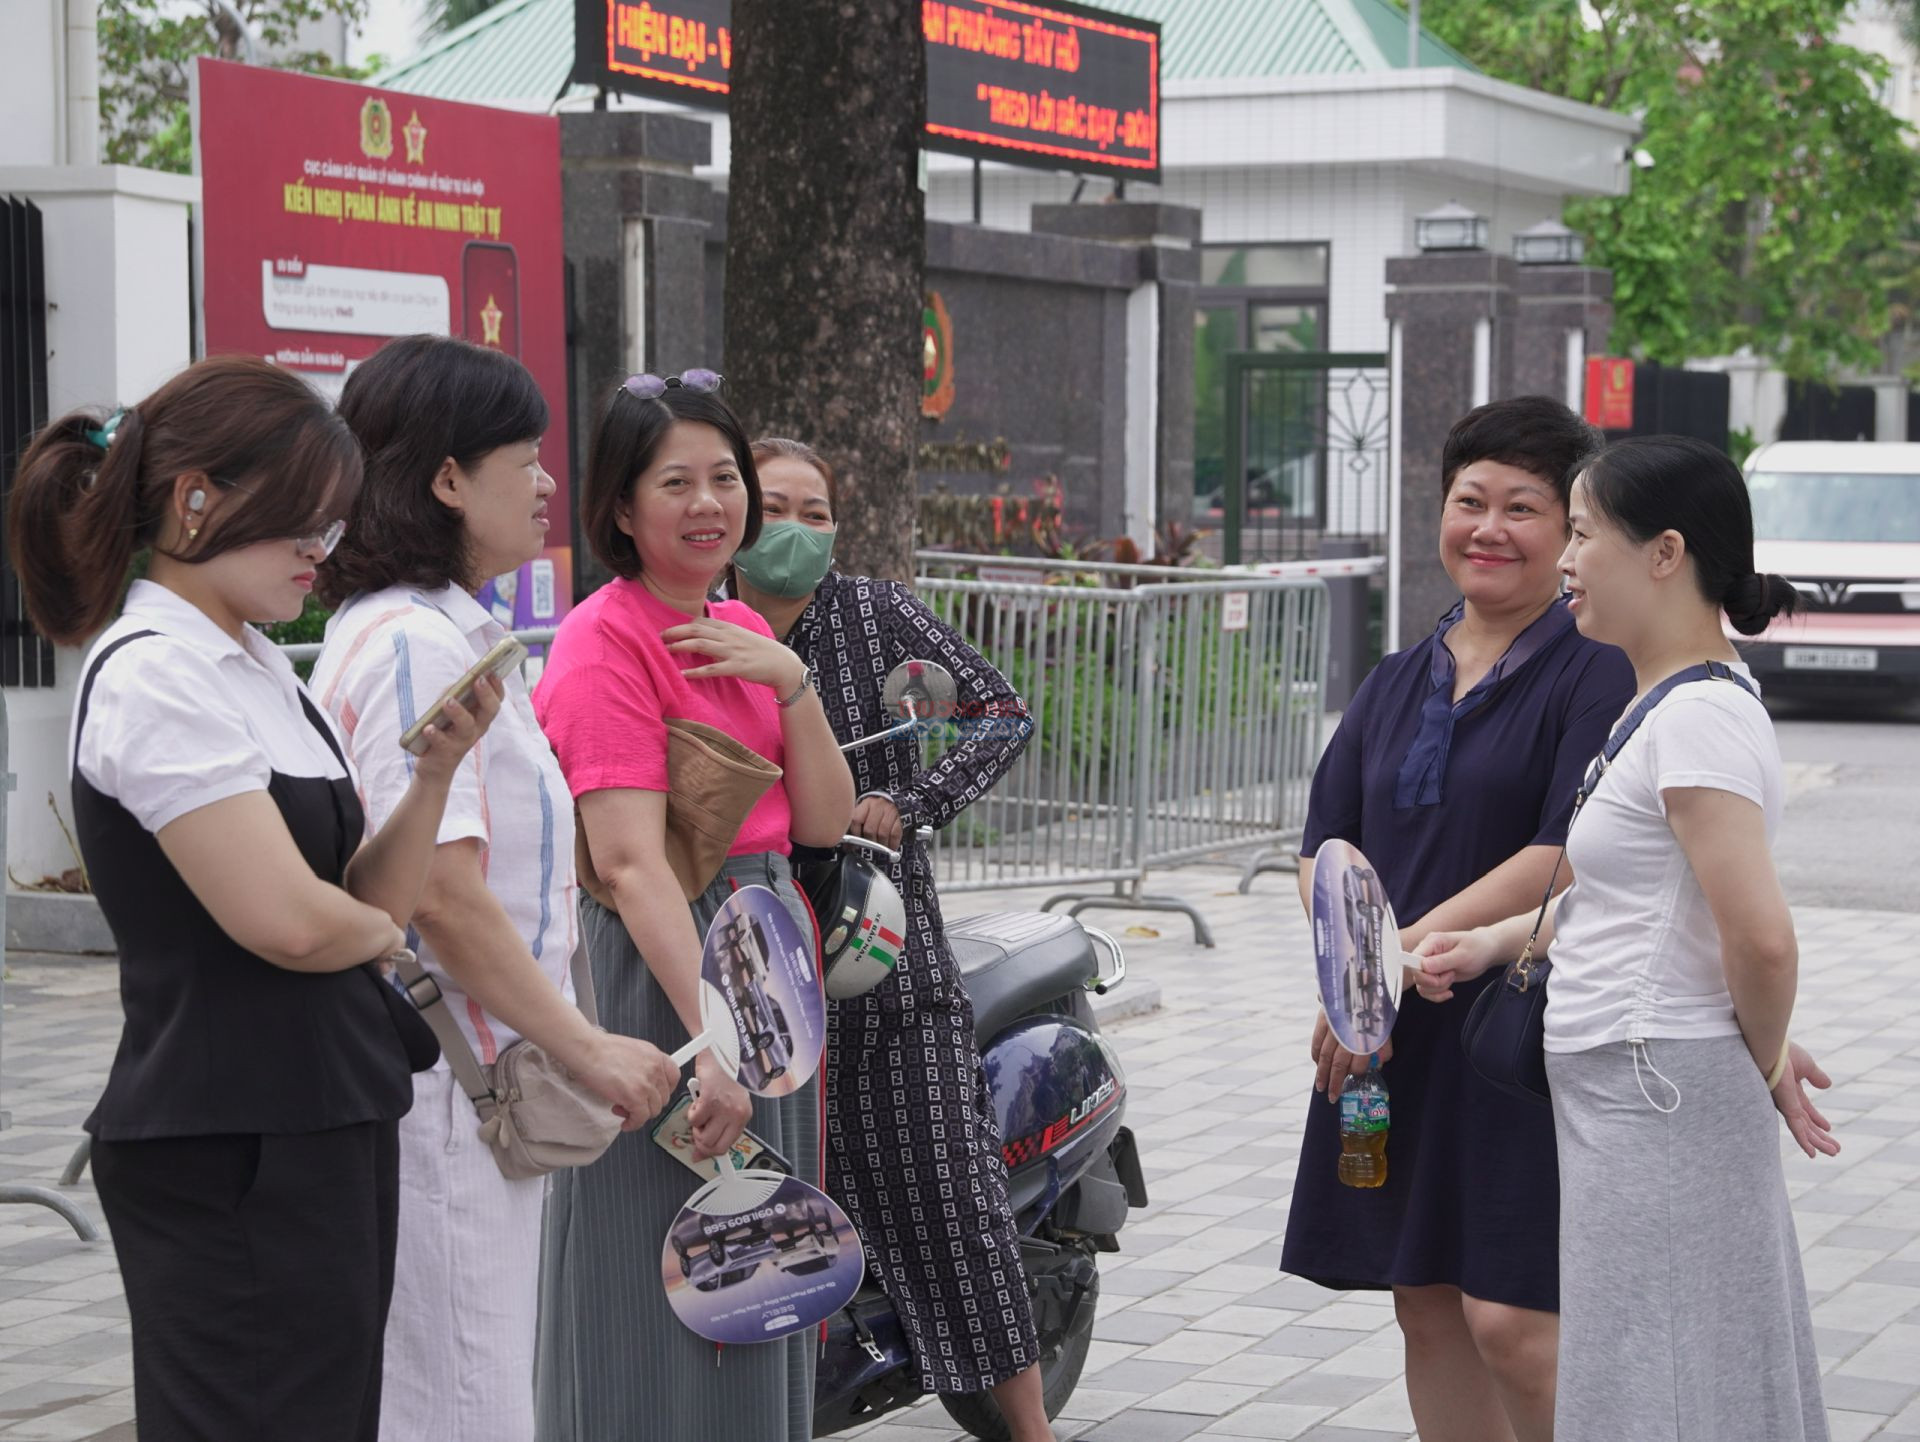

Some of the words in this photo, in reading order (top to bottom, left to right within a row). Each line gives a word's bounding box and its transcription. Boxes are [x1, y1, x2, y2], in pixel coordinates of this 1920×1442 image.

[617, 1, 668, 62] HIỆN
[669, 15, 706, 72] ĐẠI
[284, 177, 312, 214] KIẾN
[314, 187, 343, 224] NGHỊ
[344, 184, 376, 221] PHẢN
[854, 943, 869, 962] NAM
[726, 987, 755, 1058] 0911.809.568
[703, 1207, 774, 1235] 0911.809.568
[761, 1303, 796, 1320] GEELY
